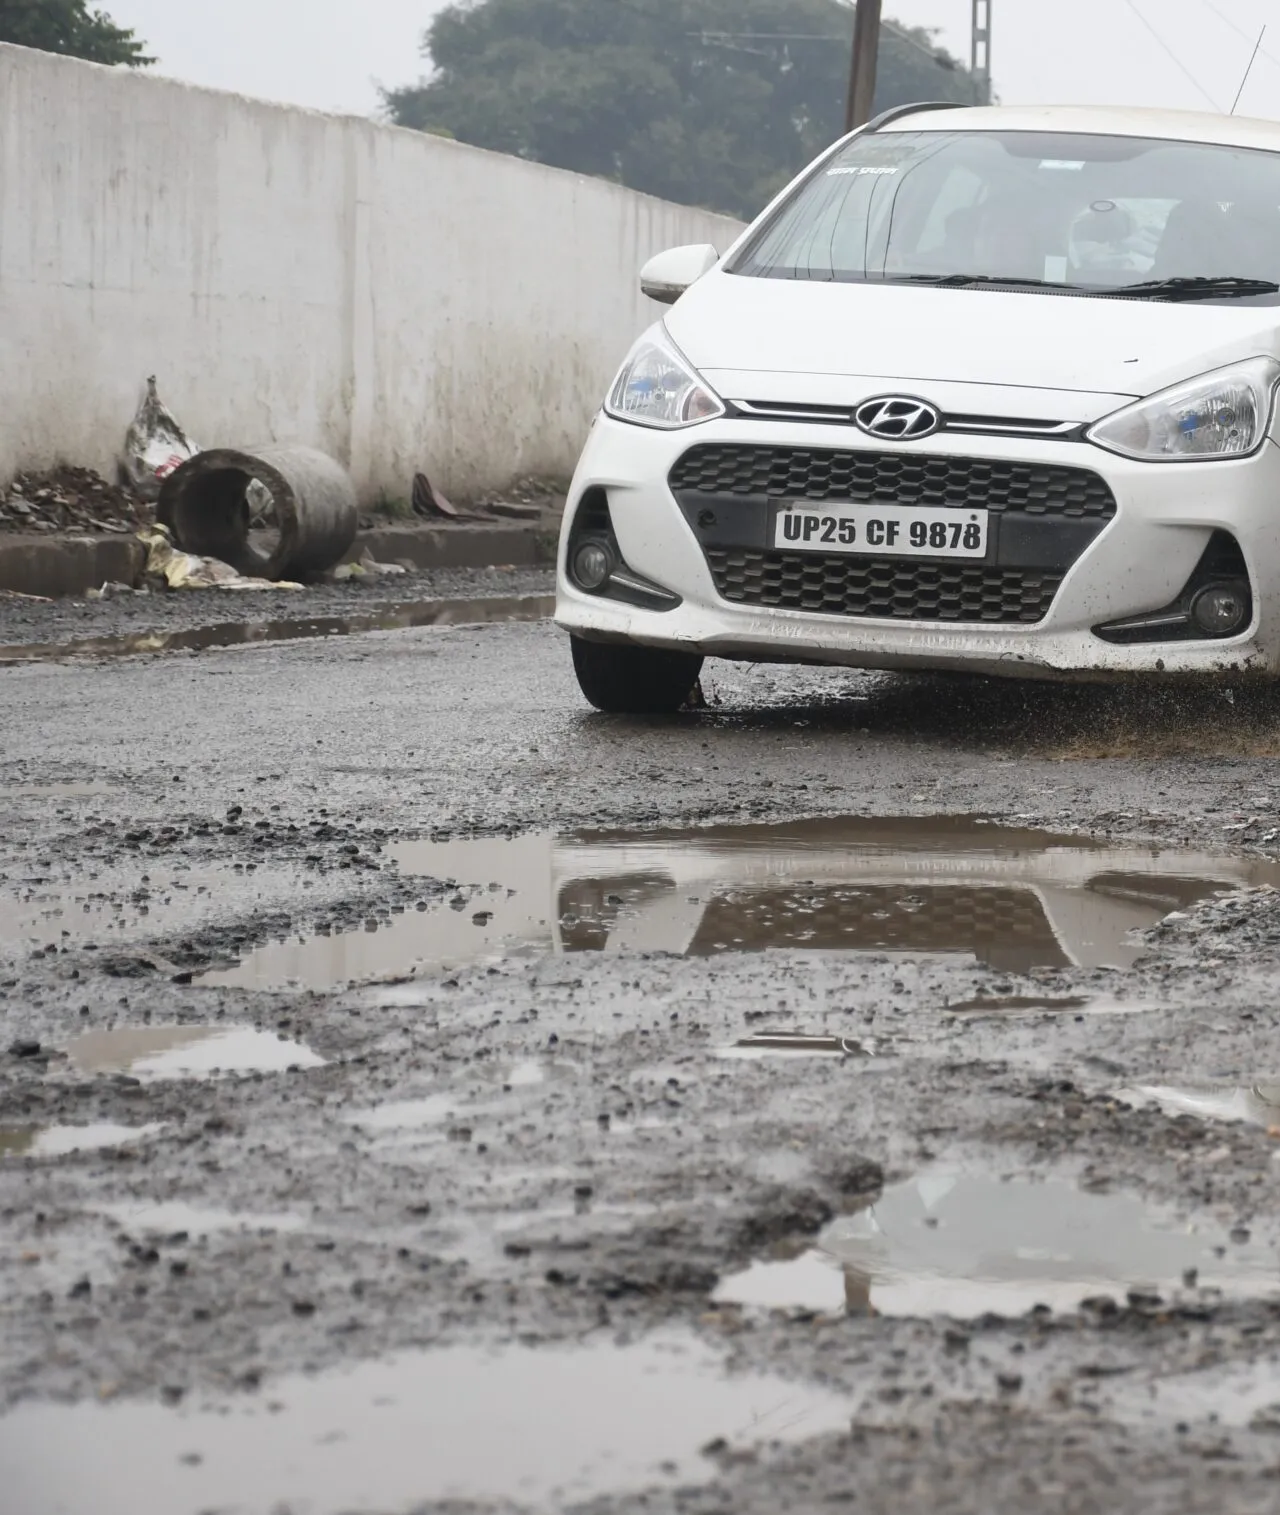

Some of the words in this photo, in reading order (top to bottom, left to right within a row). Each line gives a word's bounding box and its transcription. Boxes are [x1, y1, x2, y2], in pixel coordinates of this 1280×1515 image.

[783, 513, 857, 545] UP25
[866, 518, 900, 546] CF
[909, 520, 982, 550] 9878
